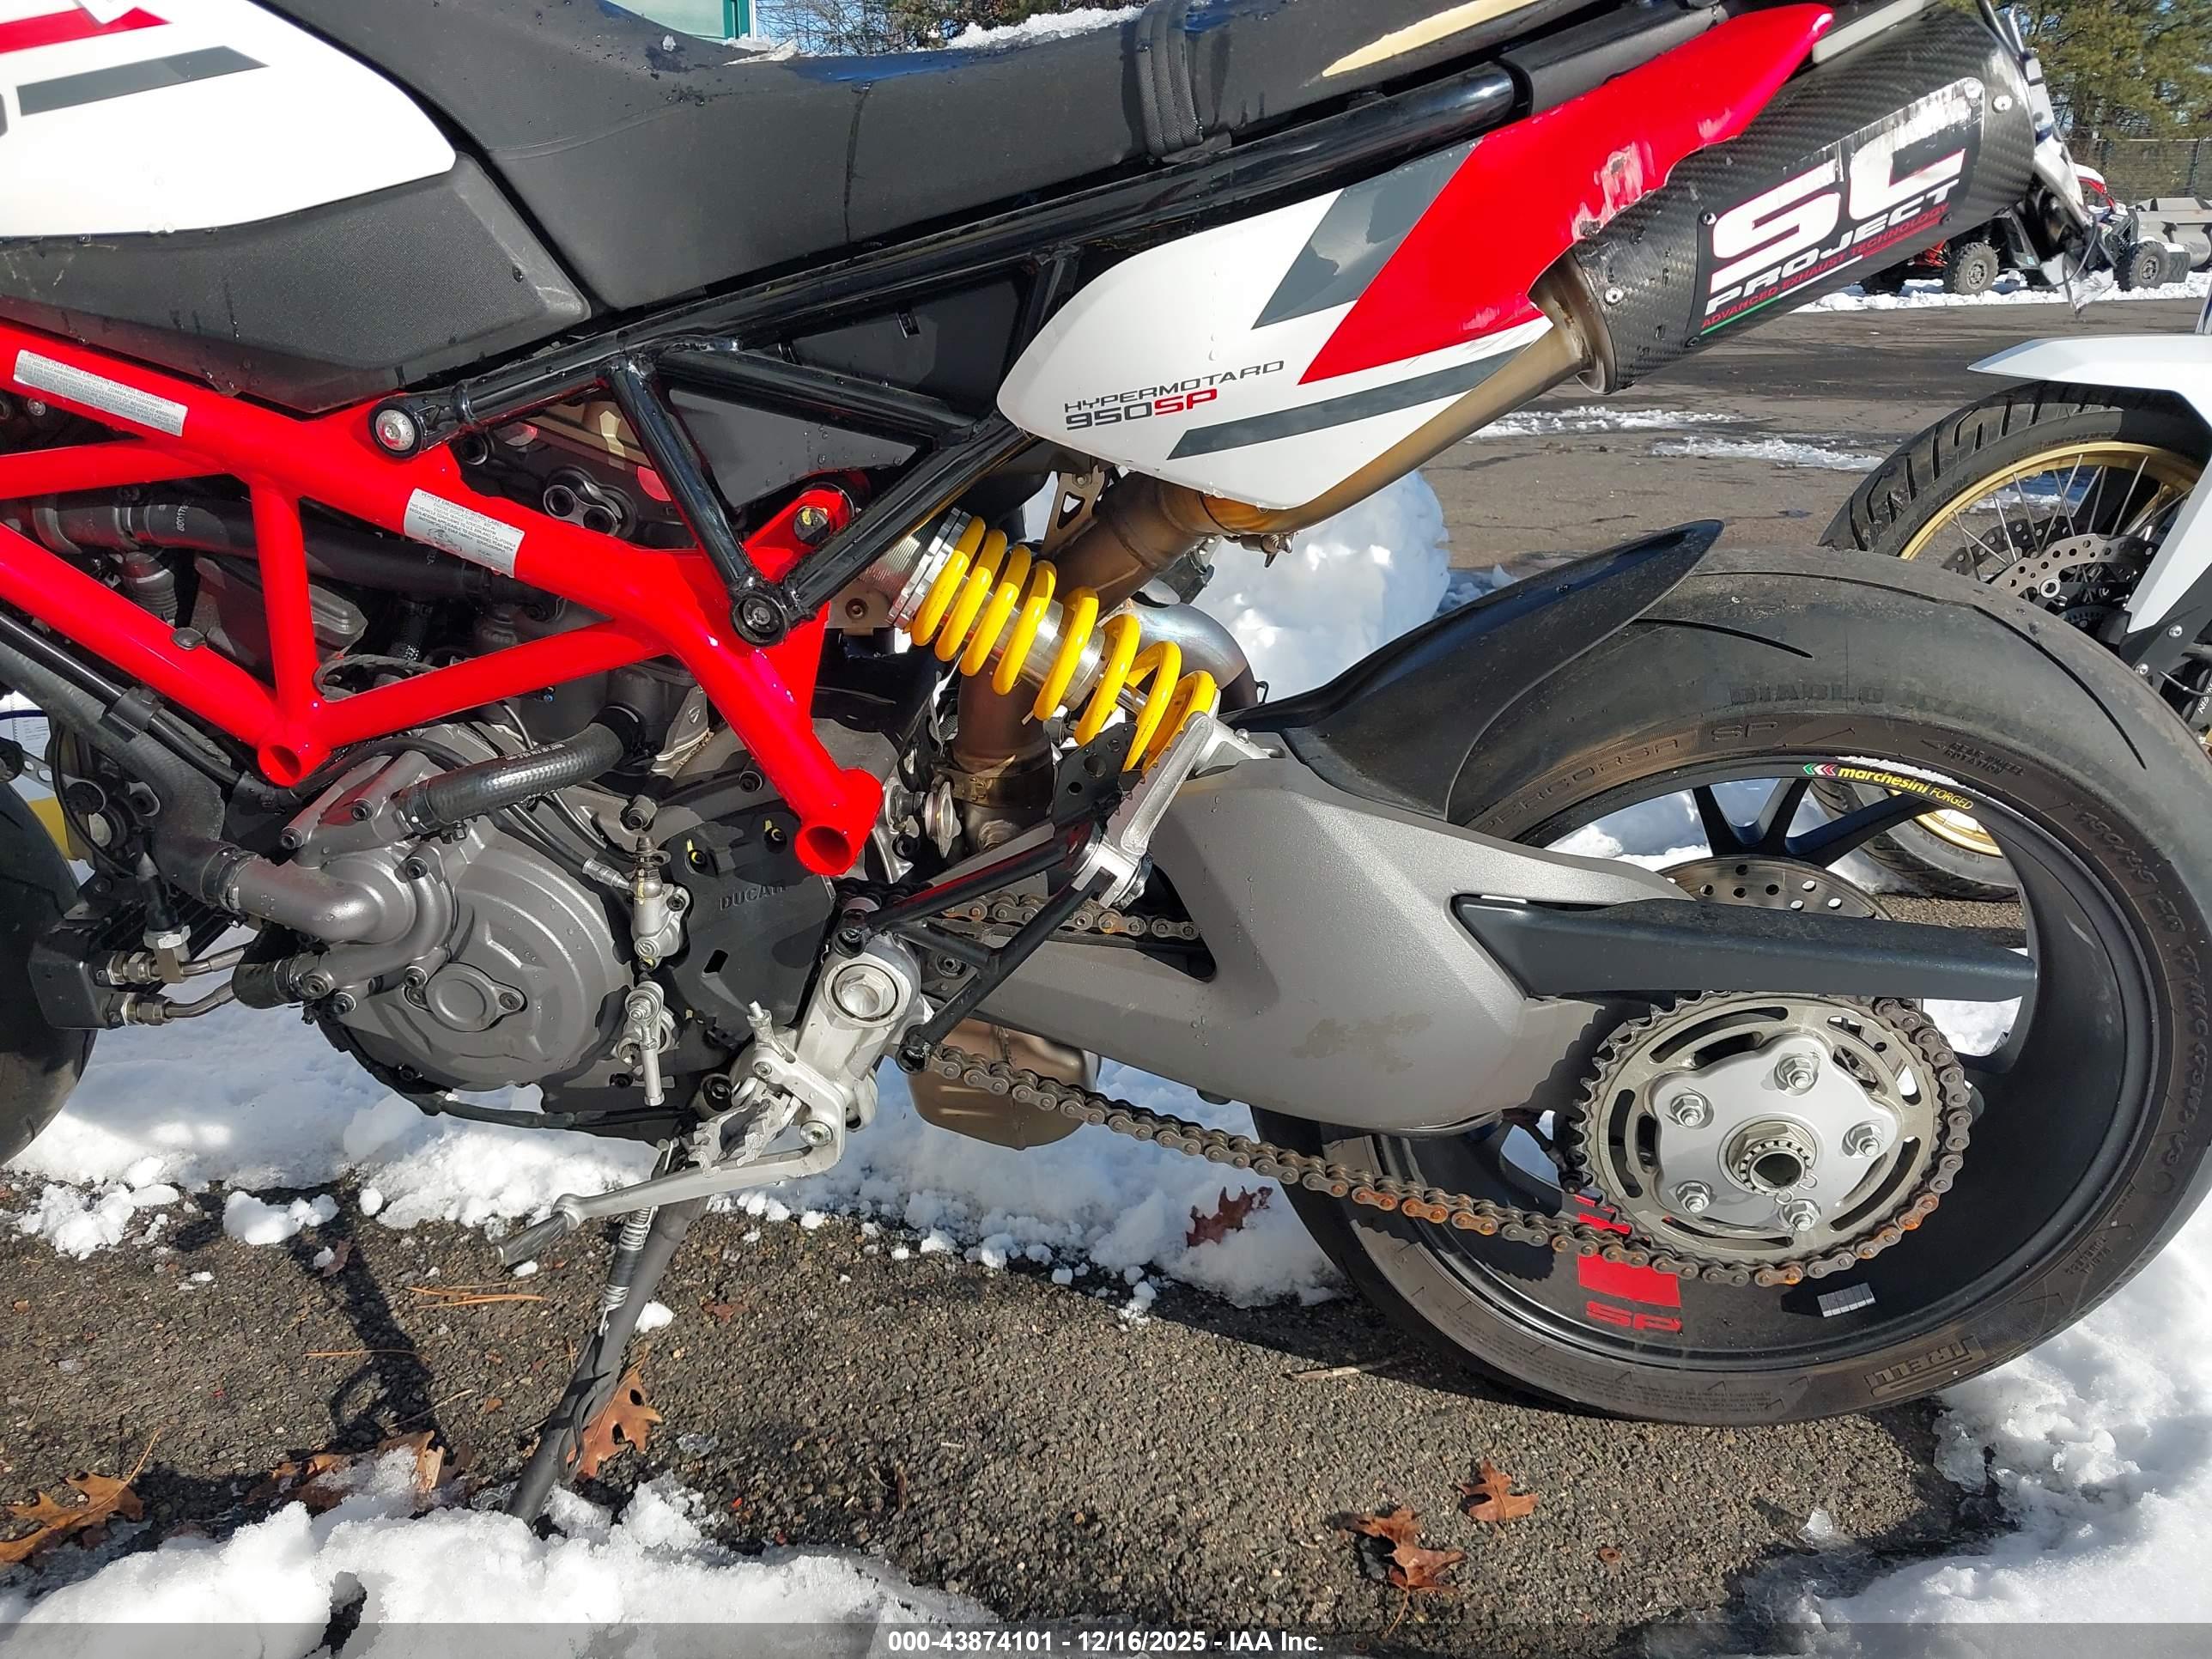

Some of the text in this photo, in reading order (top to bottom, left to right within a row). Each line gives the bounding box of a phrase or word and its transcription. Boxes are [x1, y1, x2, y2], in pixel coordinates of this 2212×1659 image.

[1702, 203, 1950, 328] ADVANCED EXHAUST TECHNOLOGY
[1705, 179, 1960, 316] PROJECT
[1065, 360, 1284, 413] HYPERMOTARD
[1066, 388, 1218, 431] 950SP
[1838, 767, 1974, 810] marchesini FORGED
[1586, 1300, 1683, 1332] SP
[1863, 1334, 1986, 1397] PIRELLI
